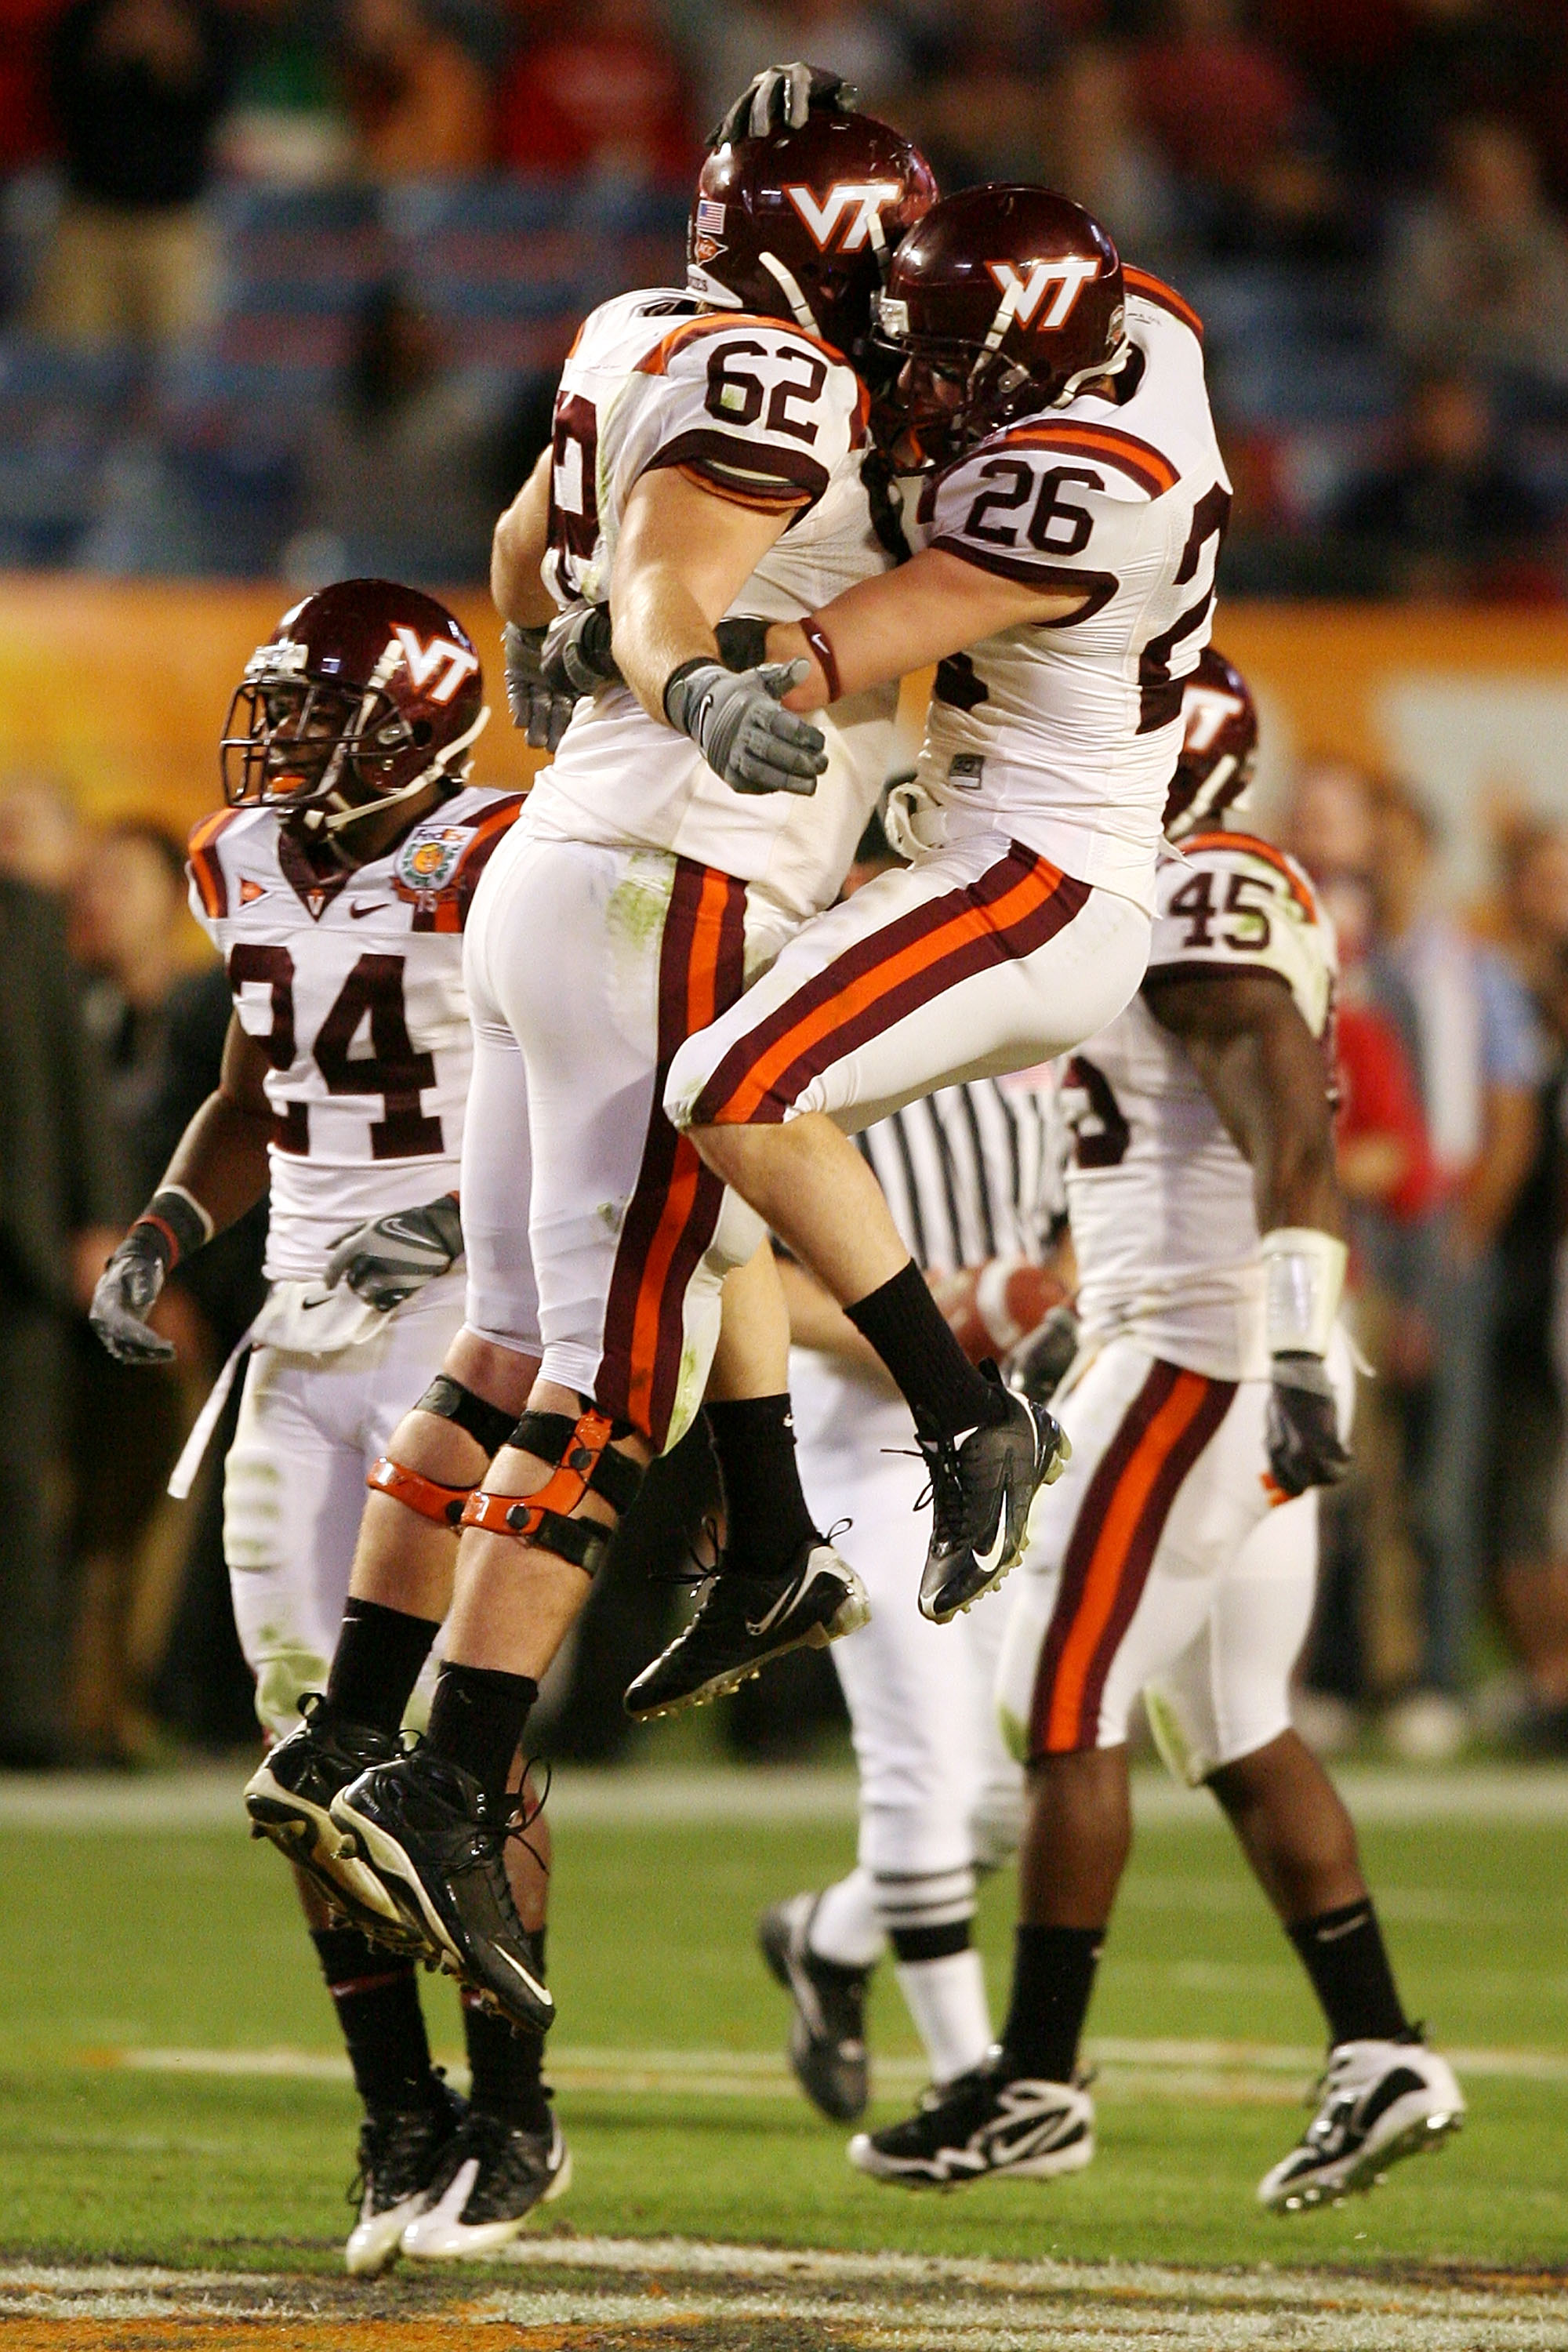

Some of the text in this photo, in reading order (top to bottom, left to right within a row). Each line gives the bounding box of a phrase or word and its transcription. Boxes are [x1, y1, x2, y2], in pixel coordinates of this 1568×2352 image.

[783, 179, 904, 253] VT
[985, 256, 1102, 332] VT
[704, 340, 827, 445] 62
[964, 459, 1105, 556] 26
[390, 622, 480, 706] VT
[1169, 872, 1275, 950] 45
[227, 943, 445, 1159] 24
